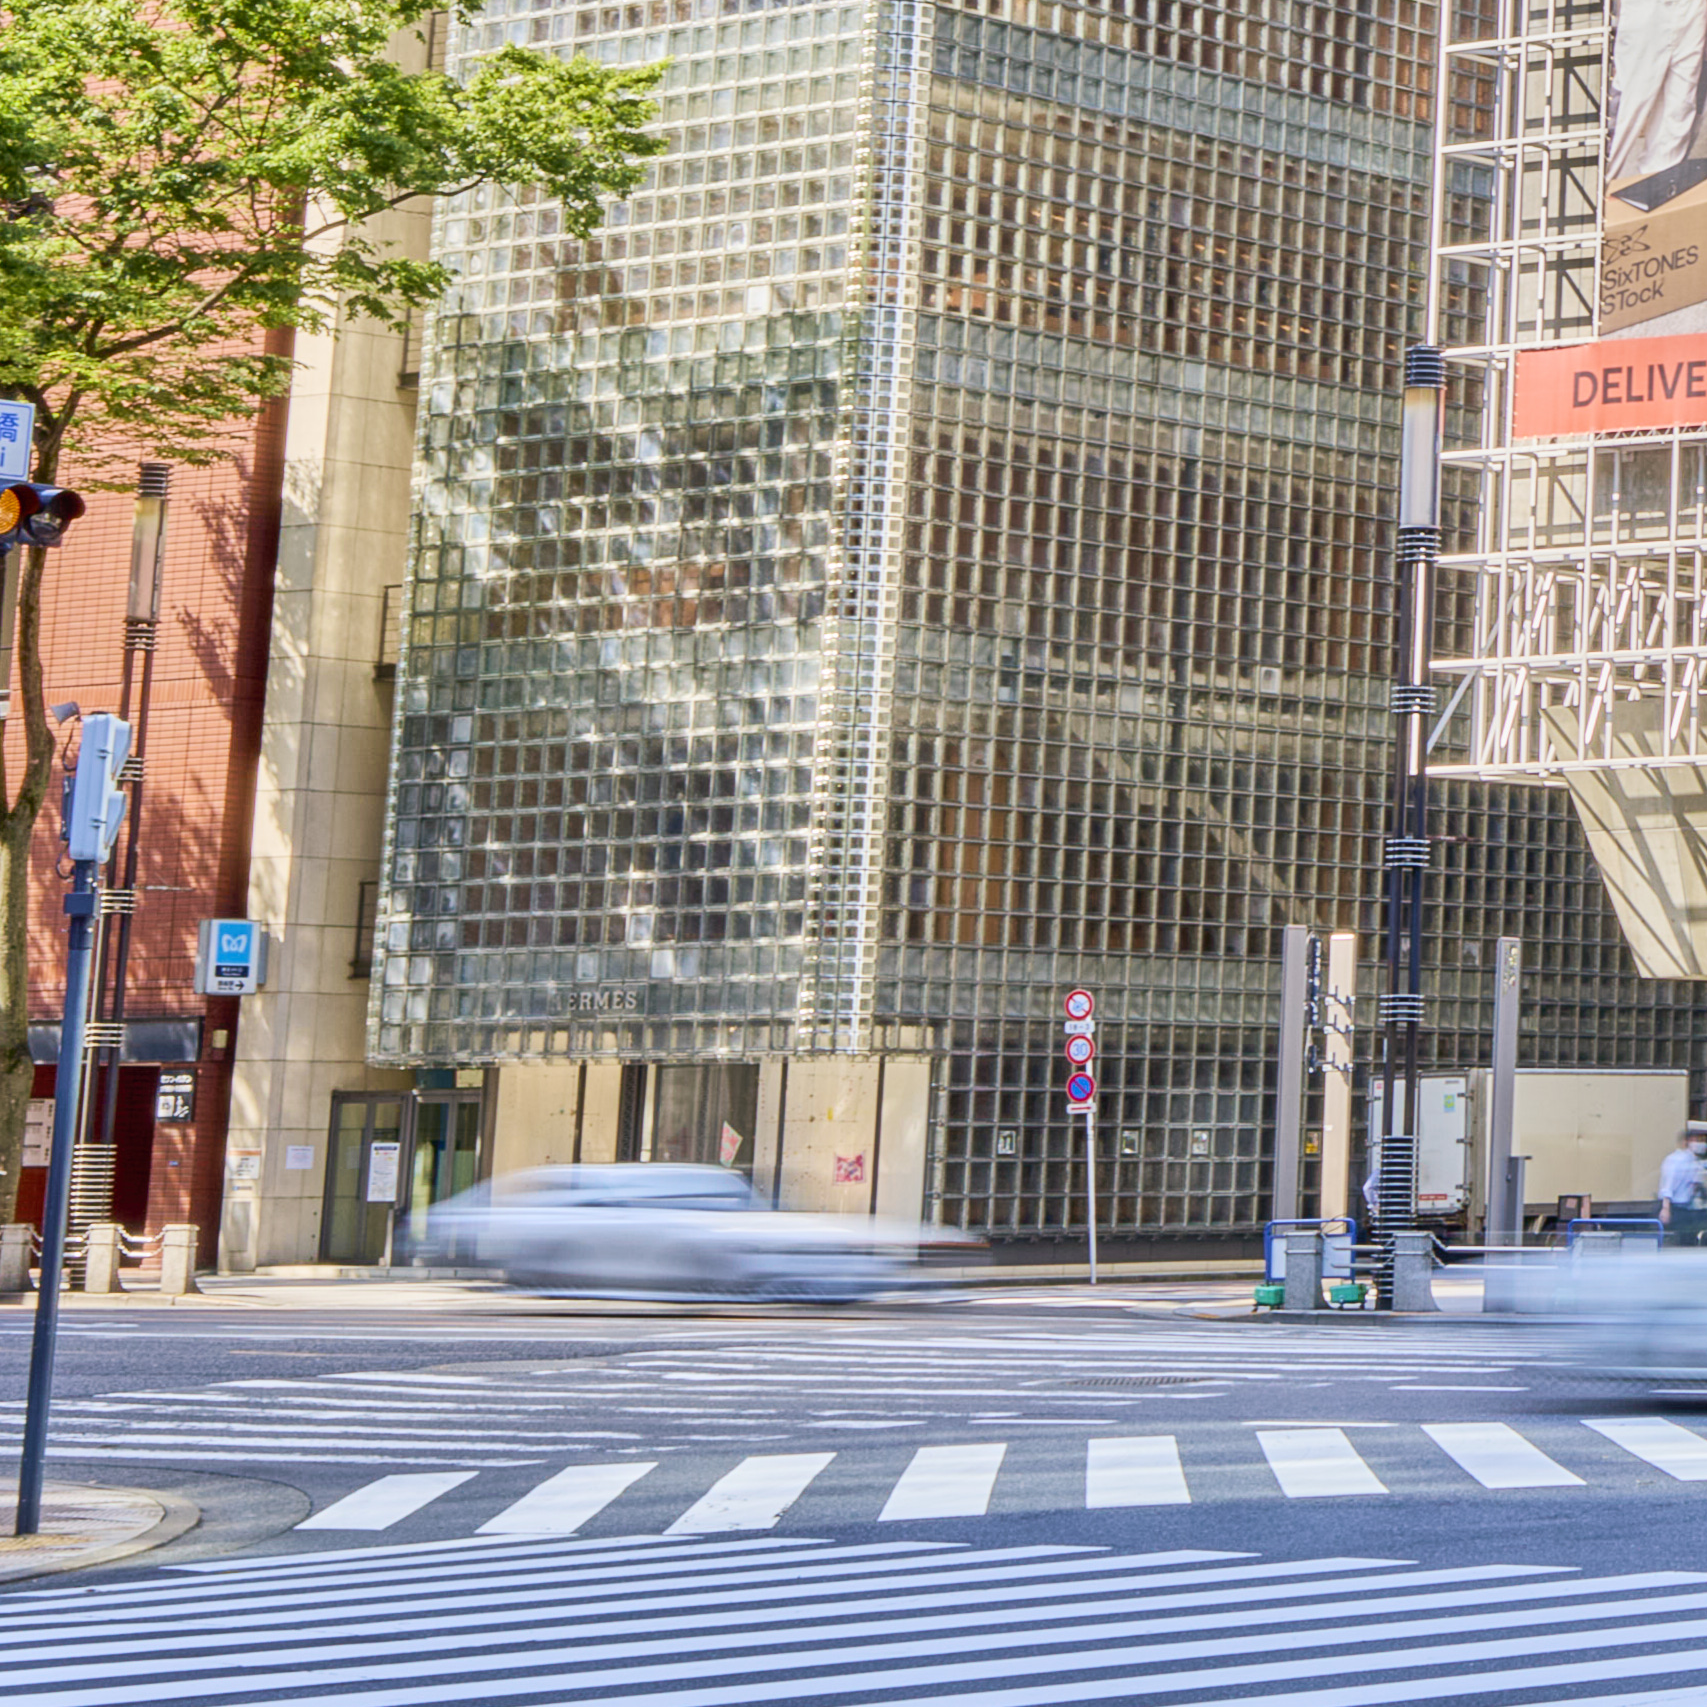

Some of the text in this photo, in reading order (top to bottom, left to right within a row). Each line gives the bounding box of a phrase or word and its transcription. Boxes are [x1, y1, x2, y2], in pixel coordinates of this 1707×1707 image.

[1604, 244, 1700, 291] SixTONES
[1602, 281, 1665, 316] STock
[1071, 1043, 1089, 1057] 30
